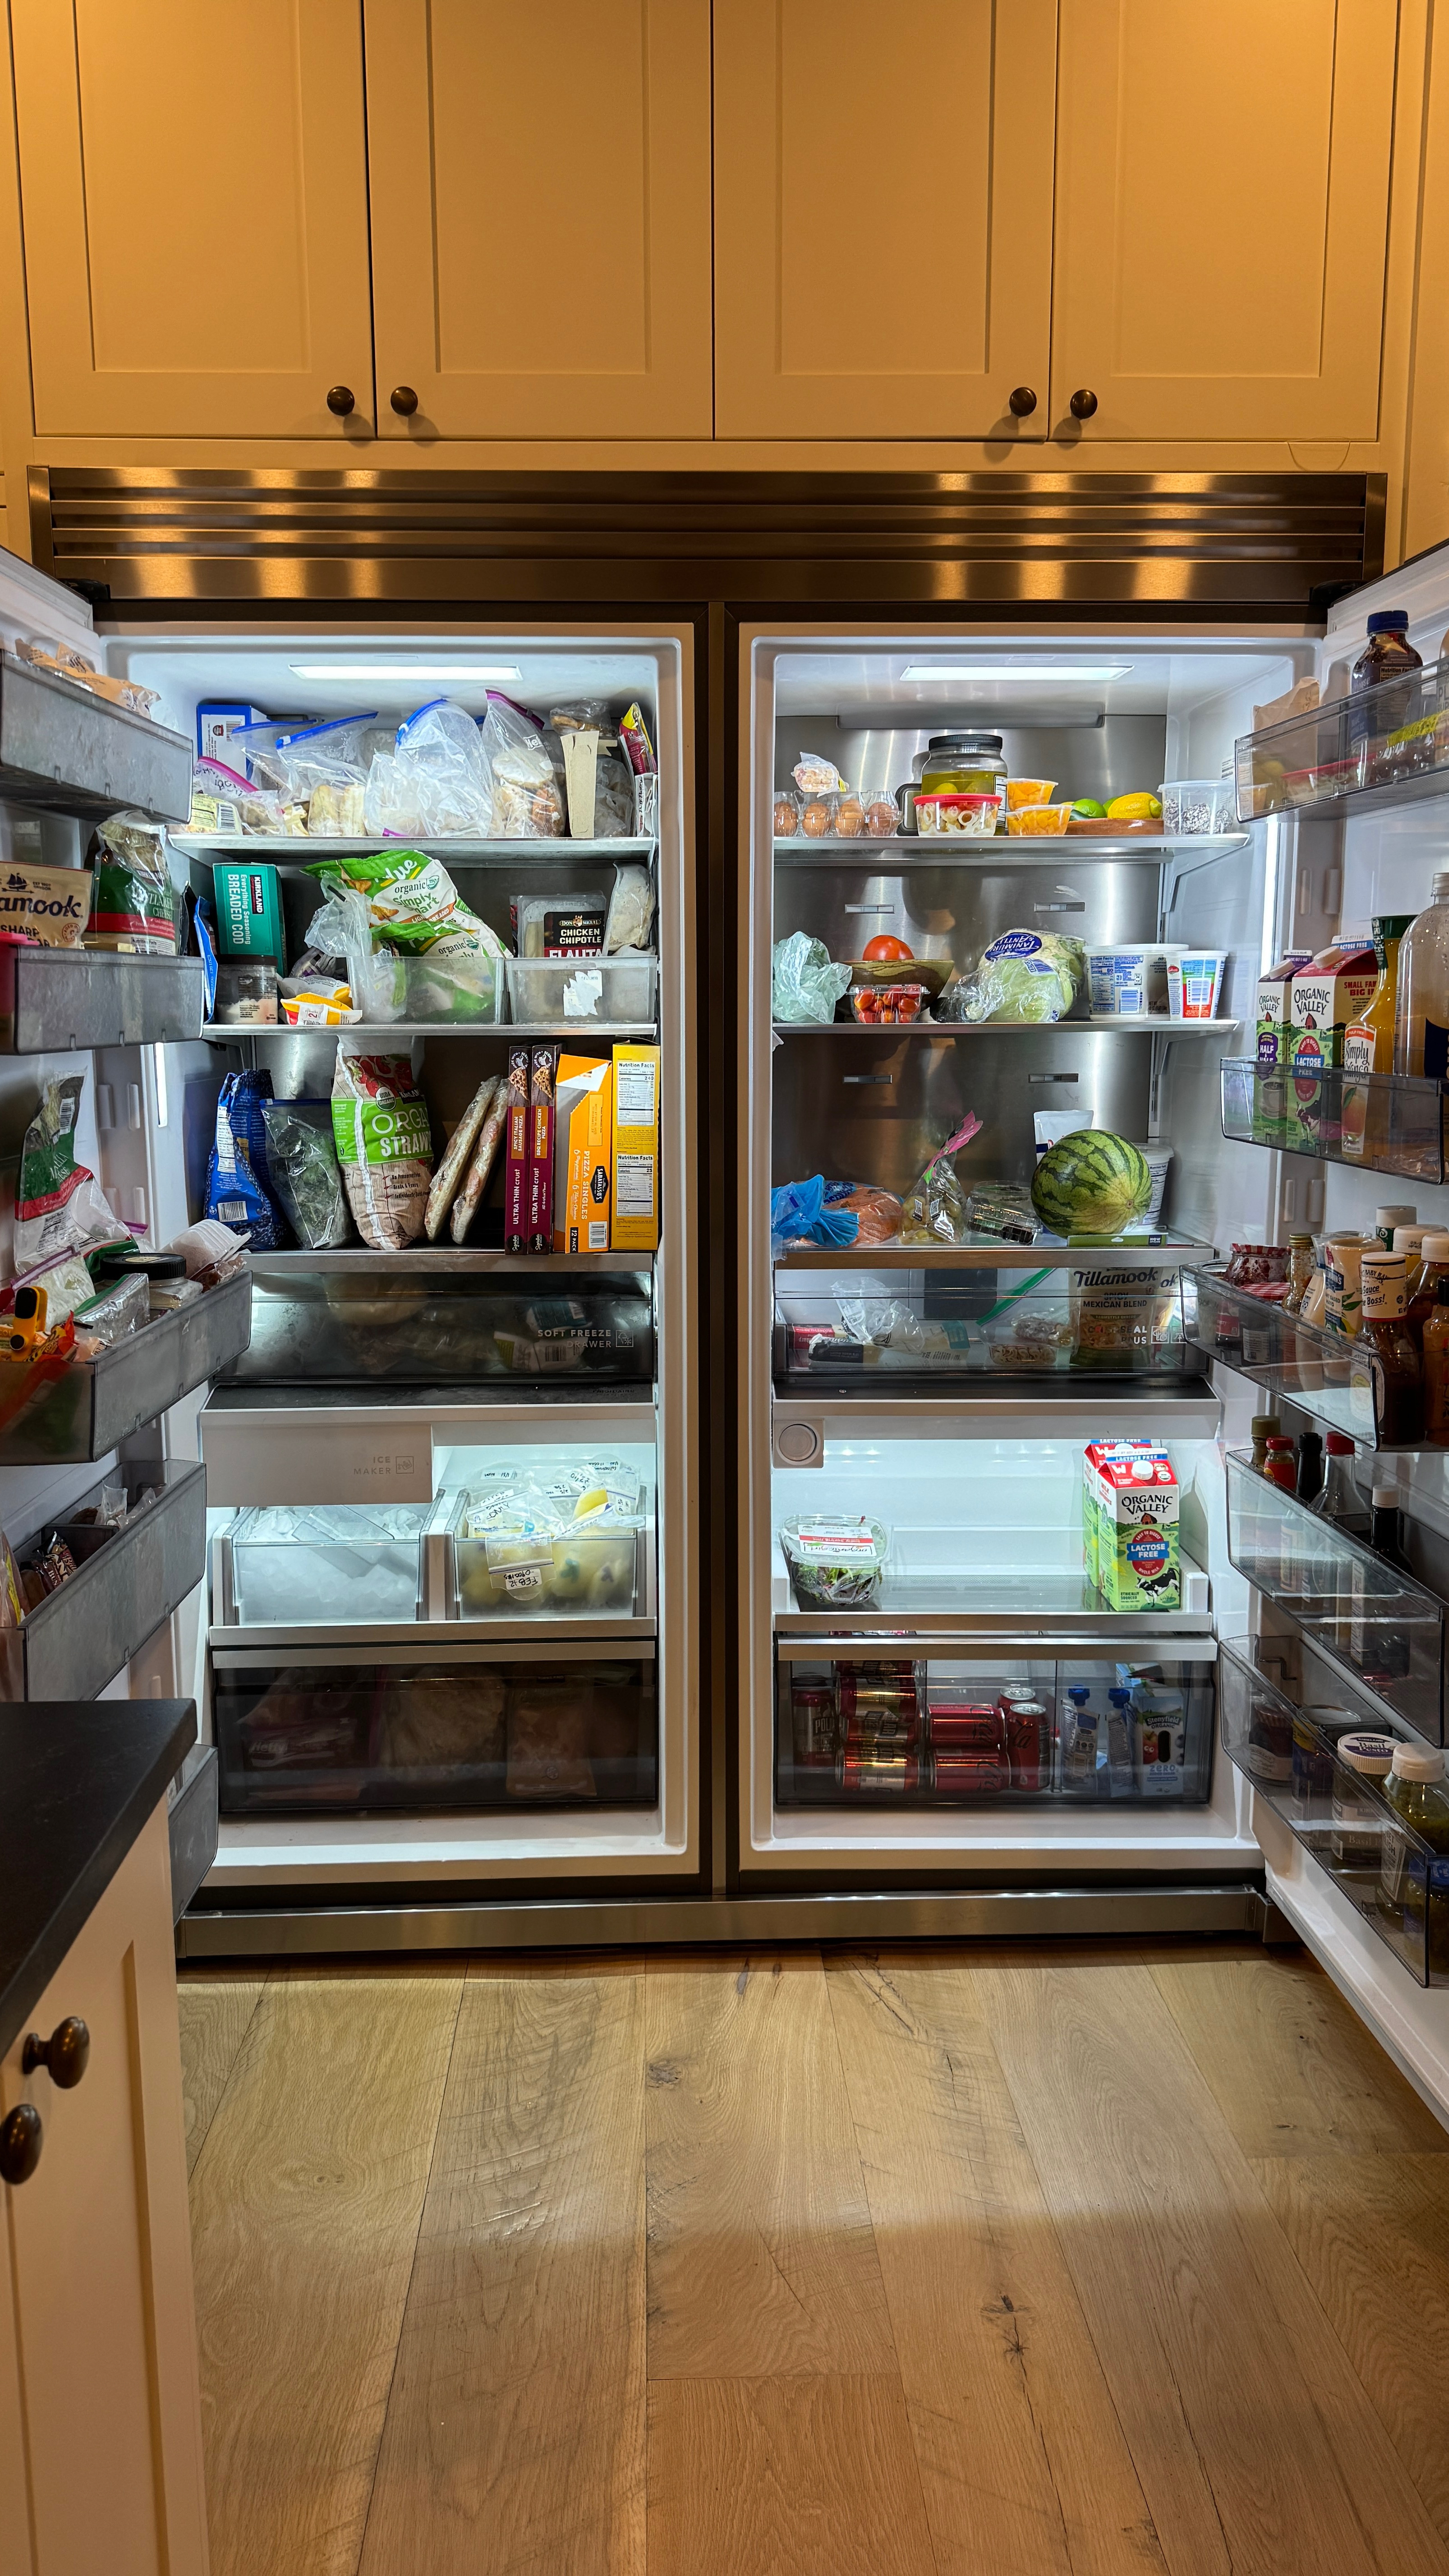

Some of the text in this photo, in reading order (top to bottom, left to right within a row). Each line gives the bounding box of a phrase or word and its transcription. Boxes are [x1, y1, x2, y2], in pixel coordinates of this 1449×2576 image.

[240, 874, 248, 909] Everything
[254, 876, 263, 913] KIRKLAND
[395, 881, 426, 894] organic
[0, 895, 82, 918] amook
[393, 892, 431, 907] Simply
[228, 874, 244, 944] BREADED COD
[561, 928, 600, 936] CHICKEN
[438, 941, 466, 955] organic
[1259, 995, 1280, 1006] ORGANIC
[1294, 988, 1330, 1003] ORGANIC
[1260, 1003, 1278, 1013] VALLEY
[1297, 1001, 1327, 1015] VALLEY
[1260, 1045, 1274, 1053] HALF
[1345, 1040, 1370, 1066] Simply
[1297, 1057, 1321, 1067] LACTOSE
[372, 1107, 430, 1134] ORGA
[380, 1131, 432, 1157] STRAW
[581, 1150, 590, 1220] PIZZA SINGLES
[1074, 1268, 1158, 1287] Tillamook
[1363, 1285, 1380, 1294] Sauce
[1367, 1293, 1385, 1305] Boss!
[1122, 1494, 1173, 1507] ORGANIC
[1126, 1504, 1169, 1515] VALLEY
[1131, 1543, 1165, 1551] LACTOSE
[518, 1577, 538, 1586] FEB
[815, 1719, 831, 1733] POL
[1147, 1716, 1179, 1724] Stonyfield
